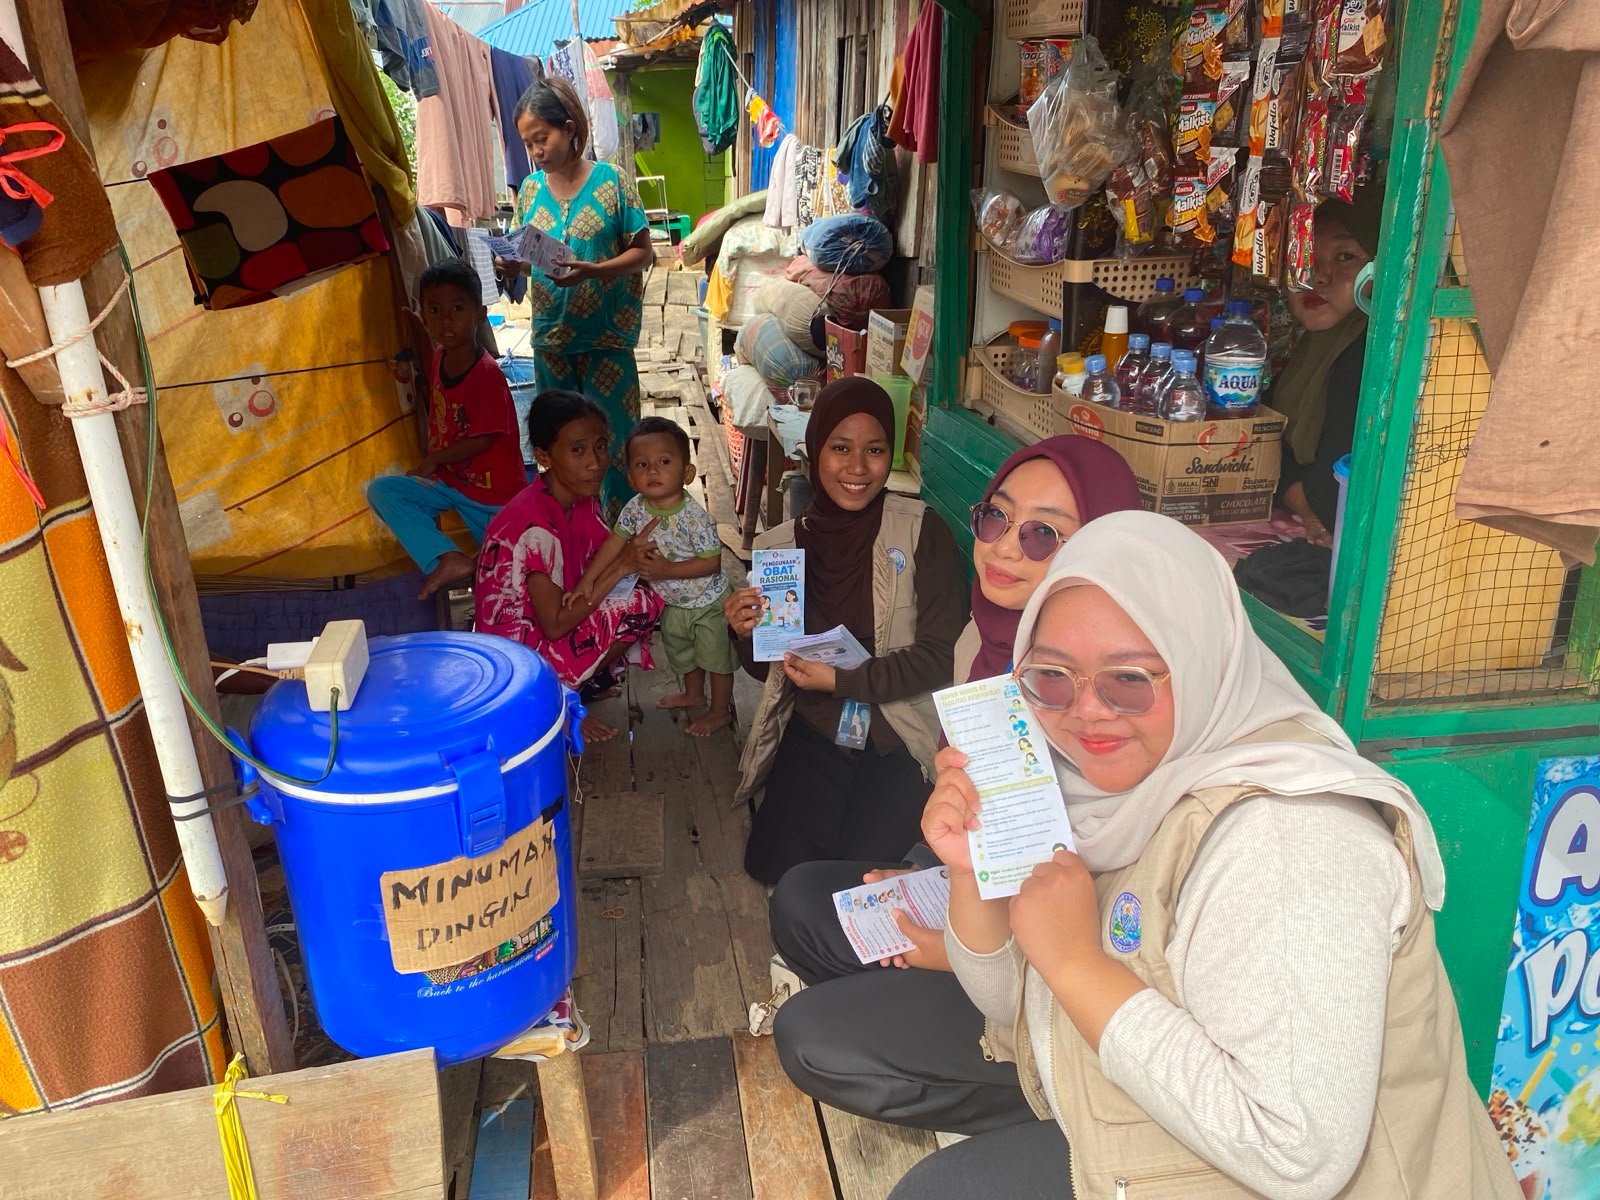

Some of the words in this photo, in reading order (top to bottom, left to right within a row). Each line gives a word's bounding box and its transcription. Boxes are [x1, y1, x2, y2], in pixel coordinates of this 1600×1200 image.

[1179, 111, 1210, 132] Malkist
[1269, 102, 1278, 147] Wafello
[1175, 192, 1206, 213] Malkist
[1256, 232, 1266, 273] Wafello
[1219, 375, 1257, 392] AQUA
[760, 574, 799, 583] RASIONAL
[763, 565, 794, 576] OBAT
[392, 825, 553, 909] MINUMAN
[417, 877, 532, 951] DINGIN
[417, 985, 452, 998] Back
[455, 983, 465, 992] to
[469, 976, 483, 988] the
